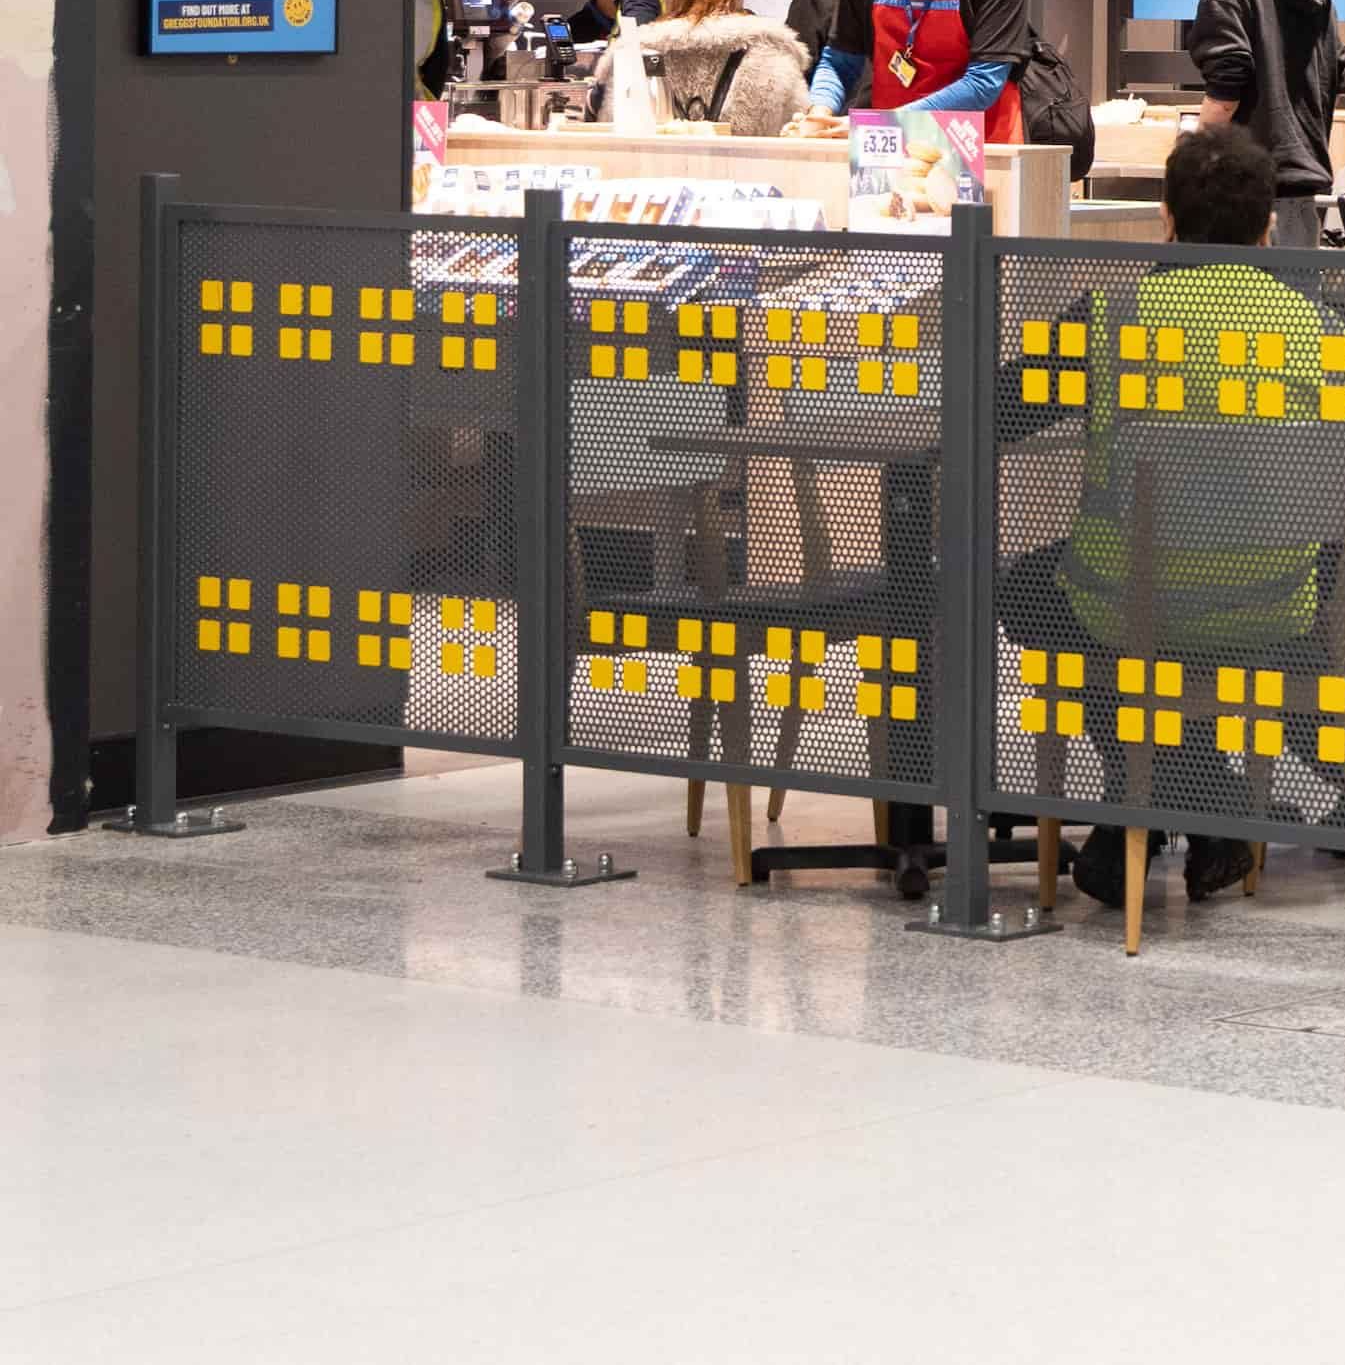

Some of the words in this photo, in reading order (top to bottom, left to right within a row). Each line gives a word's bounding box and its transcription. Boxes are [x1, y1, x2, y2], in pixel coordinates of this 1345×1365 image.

[182, 5, 201, 16] FIND
[201, 4, 217, 16] OUT
[218, 4, 240, 16] MORE
[241, 3, 251, 15] AT
[163, 15, 270, 30] GREGGSFOUNDATION.ORG.UK
[864, 135, 897, 153] £3.25
